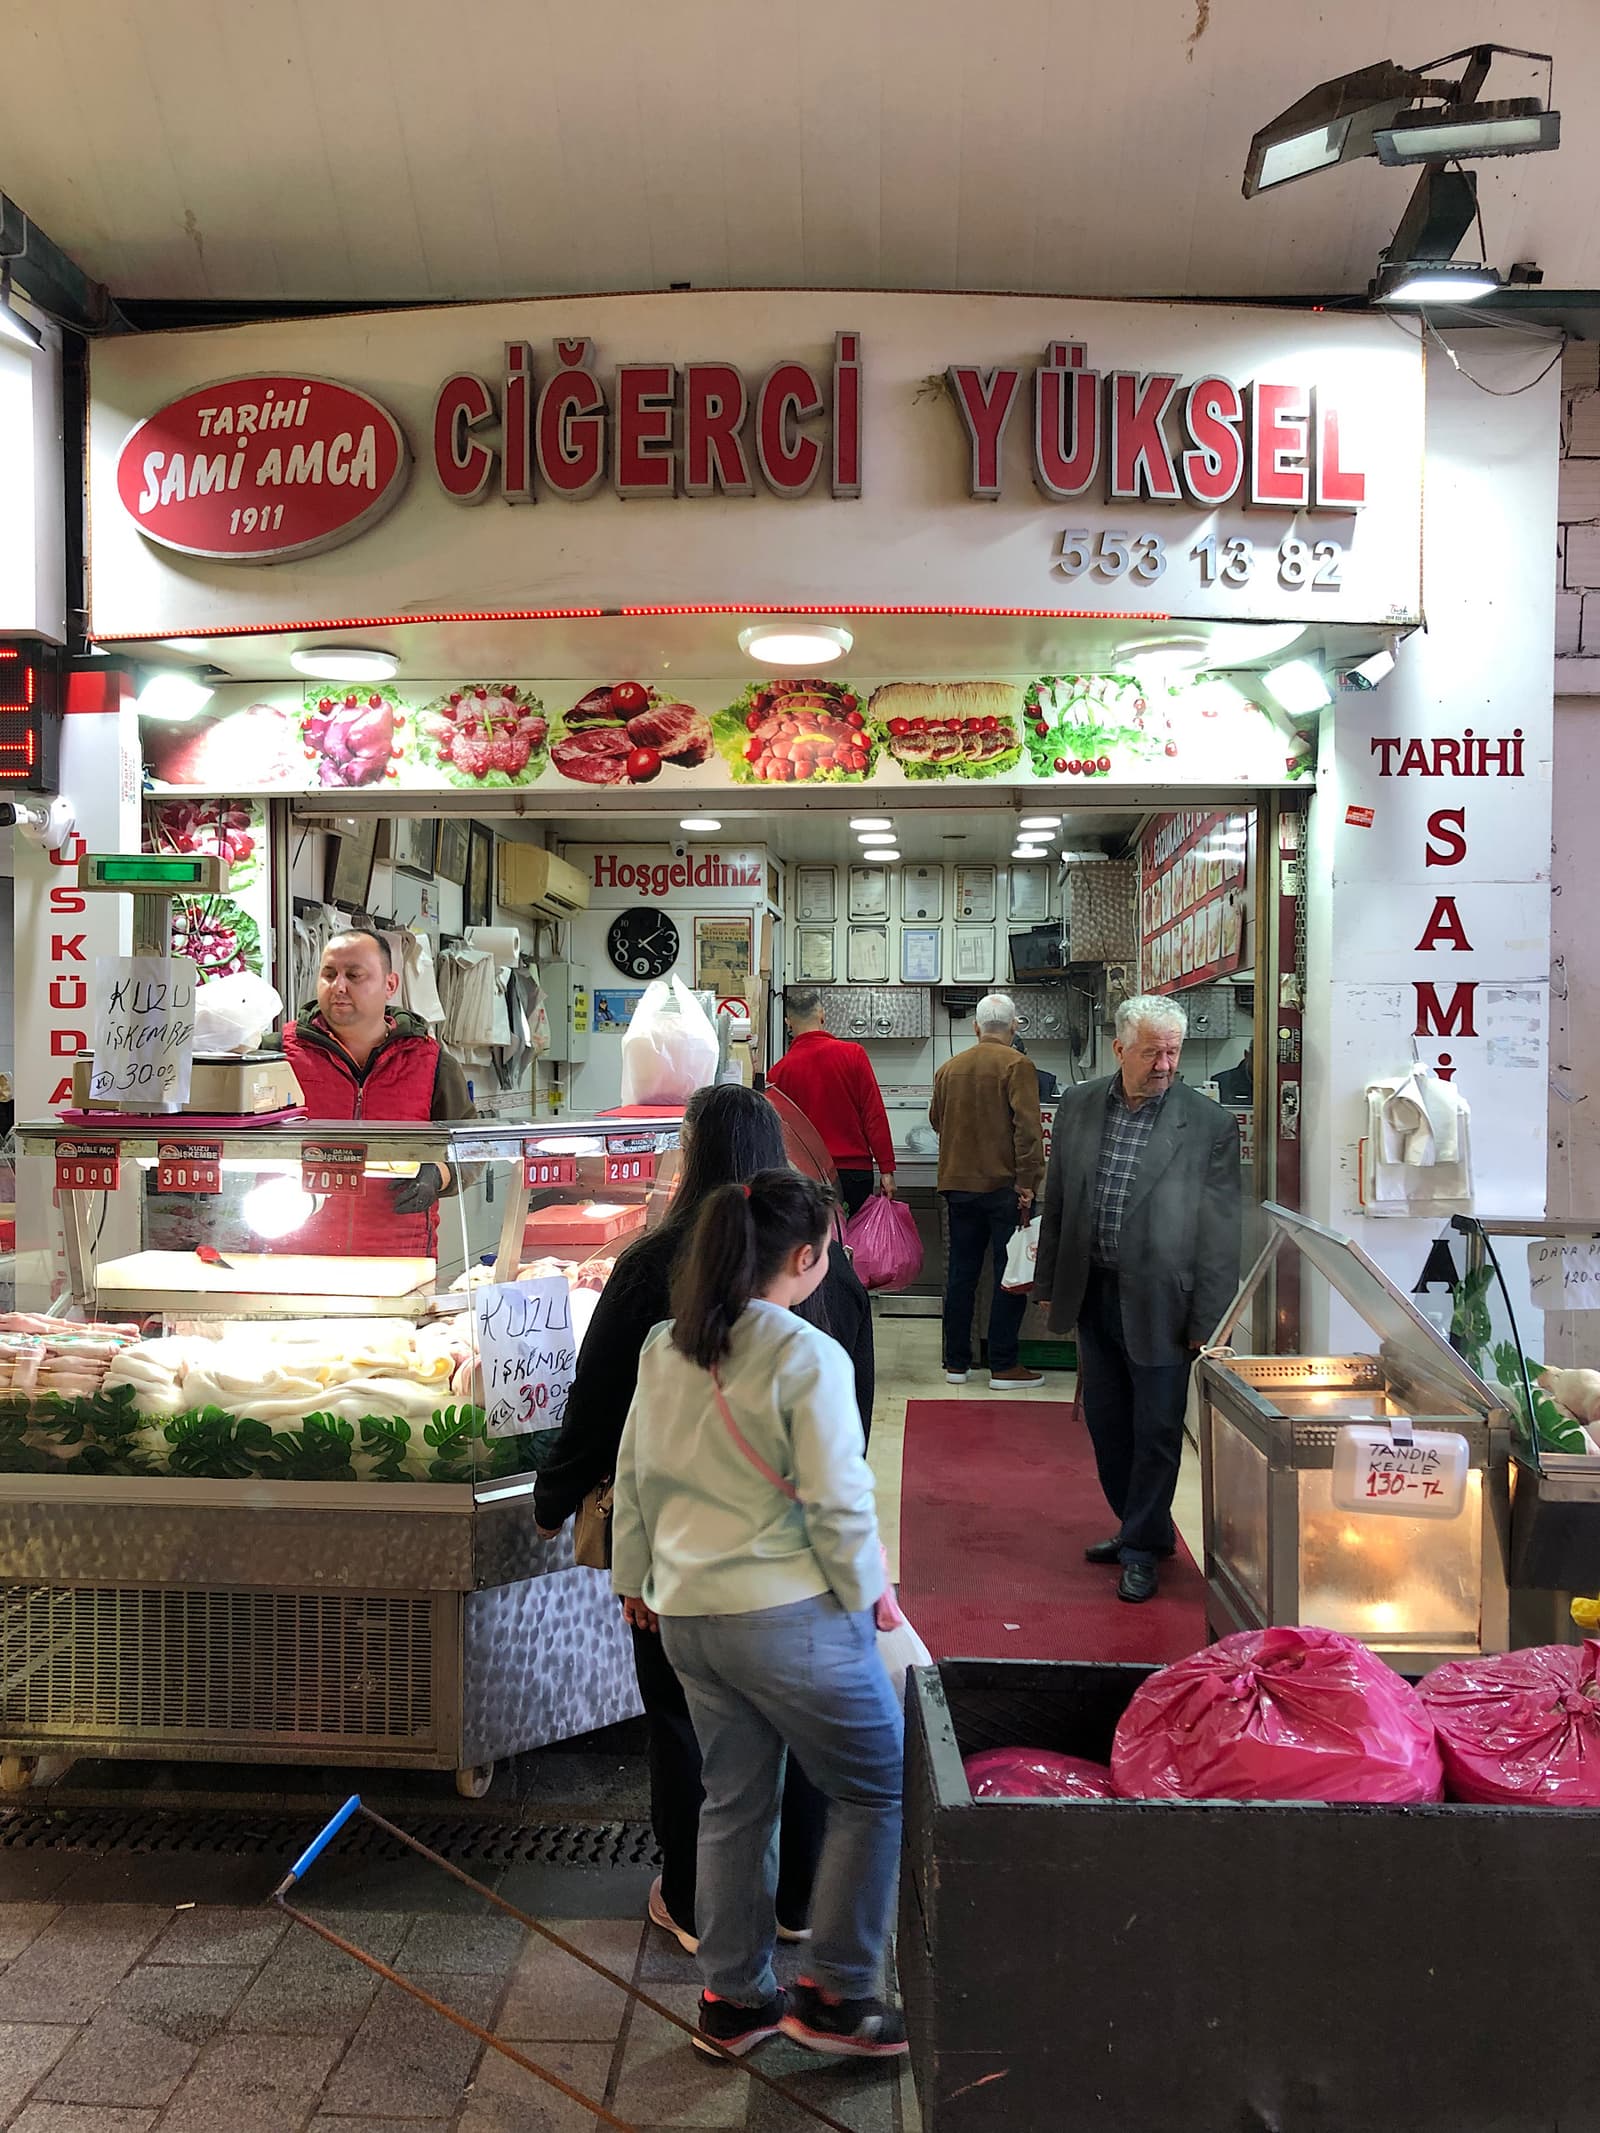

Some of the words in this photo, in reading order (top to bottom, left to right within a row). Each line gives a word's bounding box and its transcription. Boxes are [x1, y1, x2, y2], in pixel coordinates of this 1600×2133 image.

[198, 386, 311, 437] TARİHİ
[433, 331, 862, 506] CİĞERCİ
[947, 341, 1366, 513] YÜKSEL
[139, 436, 247, 514] SAMİ
[256, 425, 376, 489] AMCA
[230, 504, 284, 535] 1911
[1059, 528, 1169, 580] 553
[1192, 533, 1256, 583] 13
[1279, 538, 1344, 590] 82
[1371, 728, 1525, 776] TARİHİ
[594, 854, 761, 896] Hoşgeldiniz
[108, 978, 191, 1014] KUZU
[106, 1021, 194, 1055] İŞKEMBE
[98, 1146, 115, 1156] PAÇA
[610, 1161, 640, 1179] 290
[480, 1295, 569, 1341] KUZU
[1369, 1443, 1440, 1465] TANDIR
[1369, 1461, 1437, 1476] KELLE
